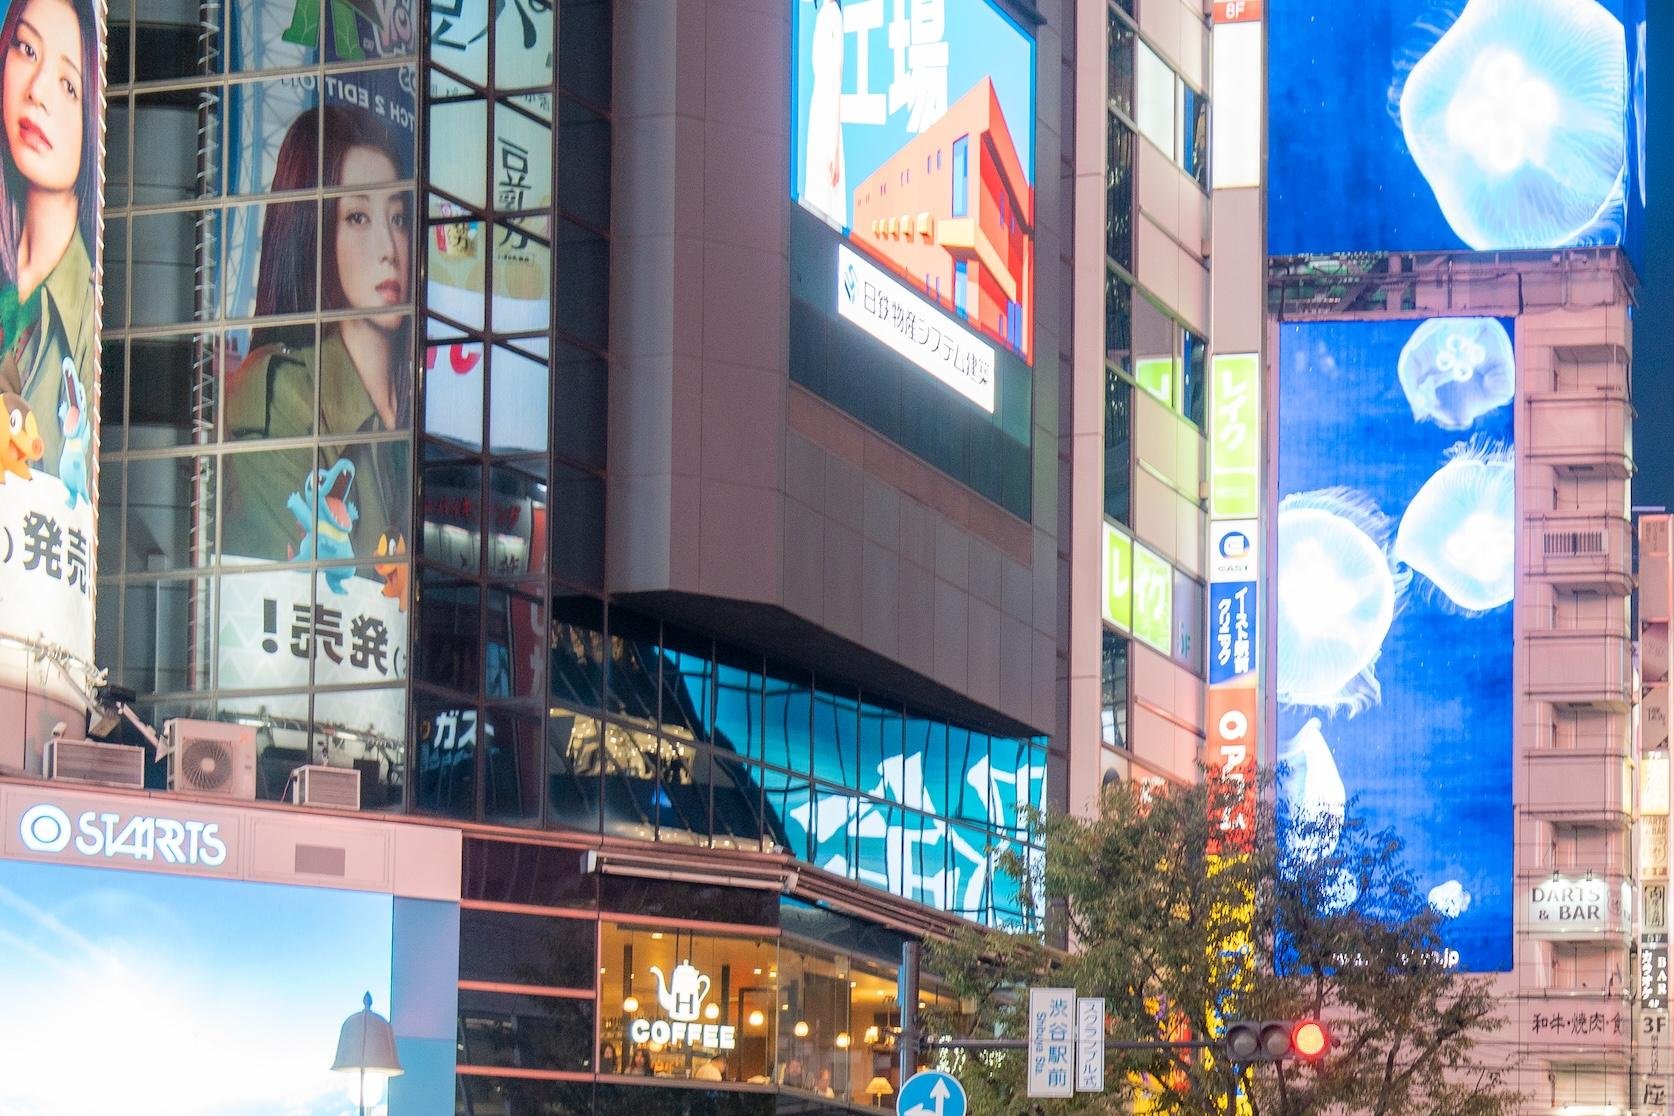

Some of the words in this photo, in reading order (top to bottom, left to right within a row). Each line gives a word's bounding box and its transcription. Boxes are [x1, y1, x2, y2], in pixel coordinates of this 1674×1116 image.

[1219, 370, 1249, 451] レイク
[1532, 887, 1600, 903] DARTS
[1559, 905, 1600, 920] BAR
[1658, 956, 1667, 995] BAR
[631, 1018, 736, 1049] COFFEE
[1643, 1016, 1667, 1034] 3F
[1048, 998, 1067, 1087] 渋谷駅前
